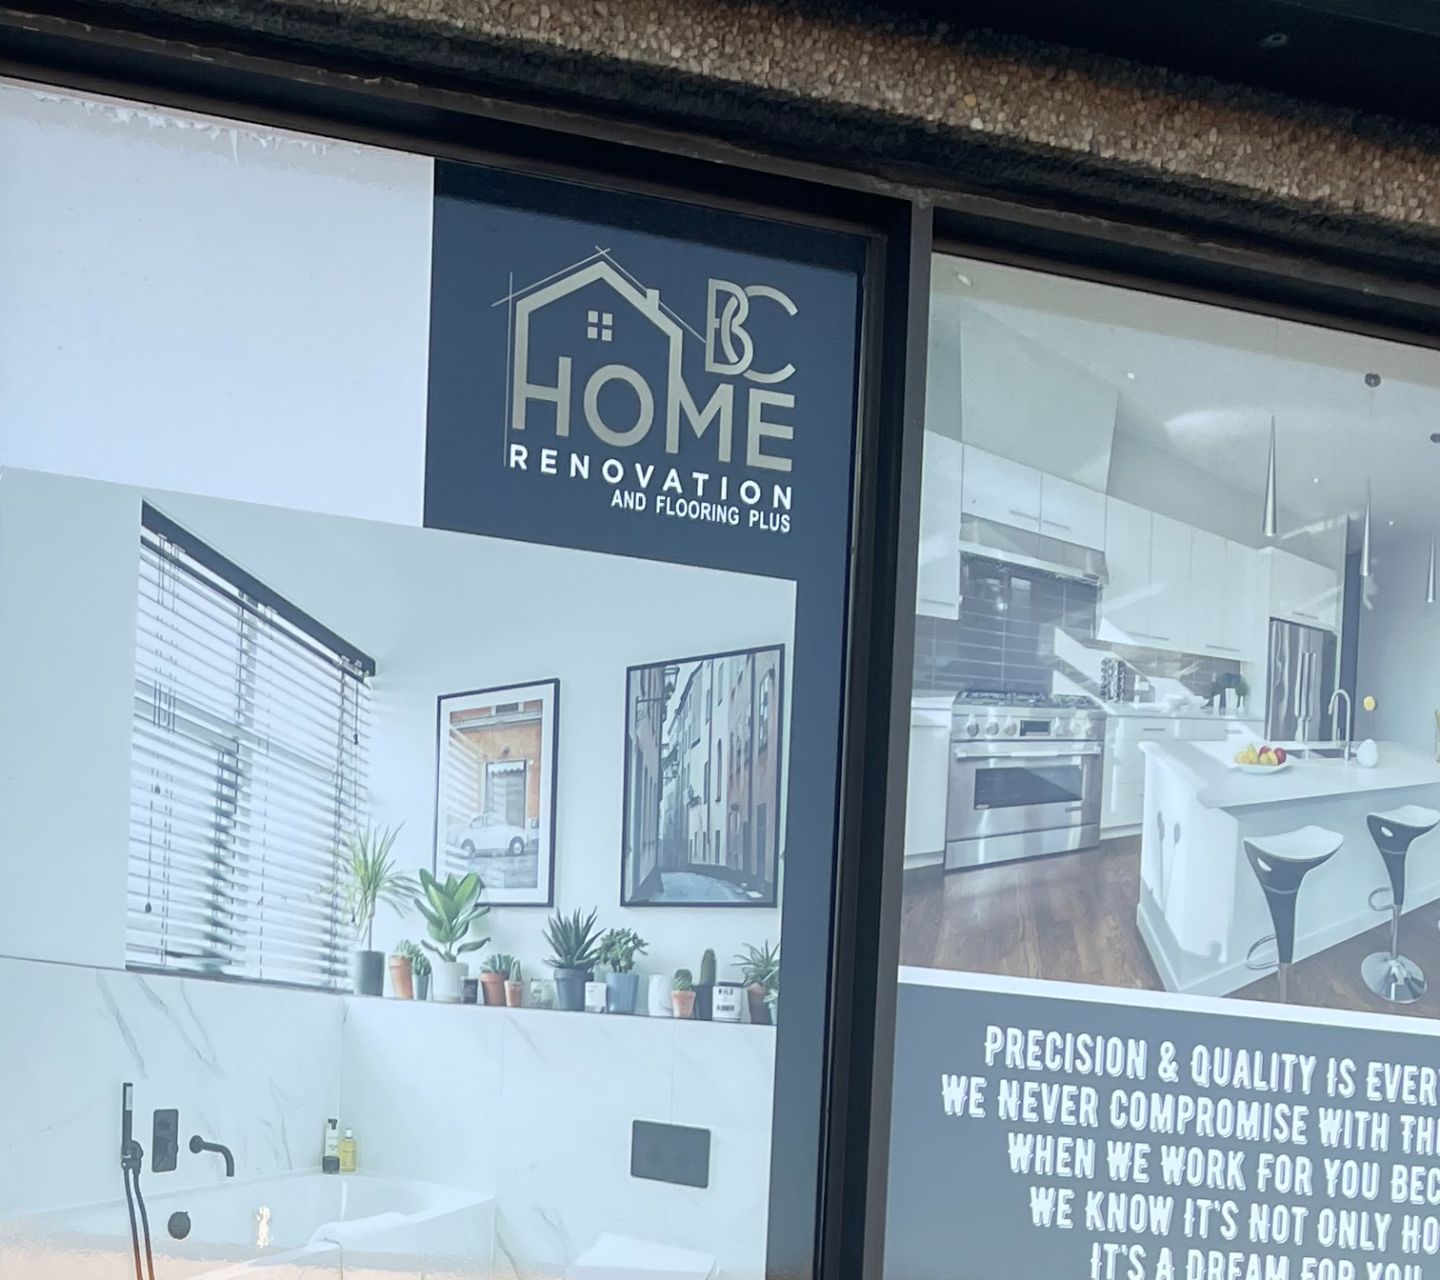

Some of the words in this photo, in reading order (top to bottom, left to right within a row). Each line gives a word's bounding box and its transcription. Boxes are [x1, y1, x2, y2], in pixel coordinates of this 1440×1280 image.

[512, 354, 795, 472] HOME
[510, 443, 792, 510] RENOVATION
[611, 489, 646, 511] AND
[656, 496, 740, 525] FLOORING
[749, 512, 791, 533] PLUS
[984, 1025, 1148, 1080] PRECISION
[1158, 1041, 1179, 1084] &
[1191, 1045, 1317, 1095] QUALITY
[1326, 1058, 1357, 1098] IS
[941, 1074, 987, 1119] WE
[998, 1080, 1099, 1127] NEVER
[1110, 1089, 1309, 1146] COMPROMISE
[1319, 1107, 1390, 1152] WITH
[1400, 1115, 1440, 1157] TH
[1008, 1132, 1096, 1179] WHEN
[1107, 1140, 1150, 1184] WE
[1160, 1145, 1247, 1192] WORK
[1257, 1152, 1313, 1196] FOR
[1323, 1158, 1380, 1201] YOU
[1030, 1186, 1075, 1229] WE
[1086, 1191, 1173, 1238] KNOW
[1183, 1198, 1239, 1241] IT'S
[1249, 1202, 1309, 1247] NOT
[1317, 1207, 1392, 1252] ONLY
